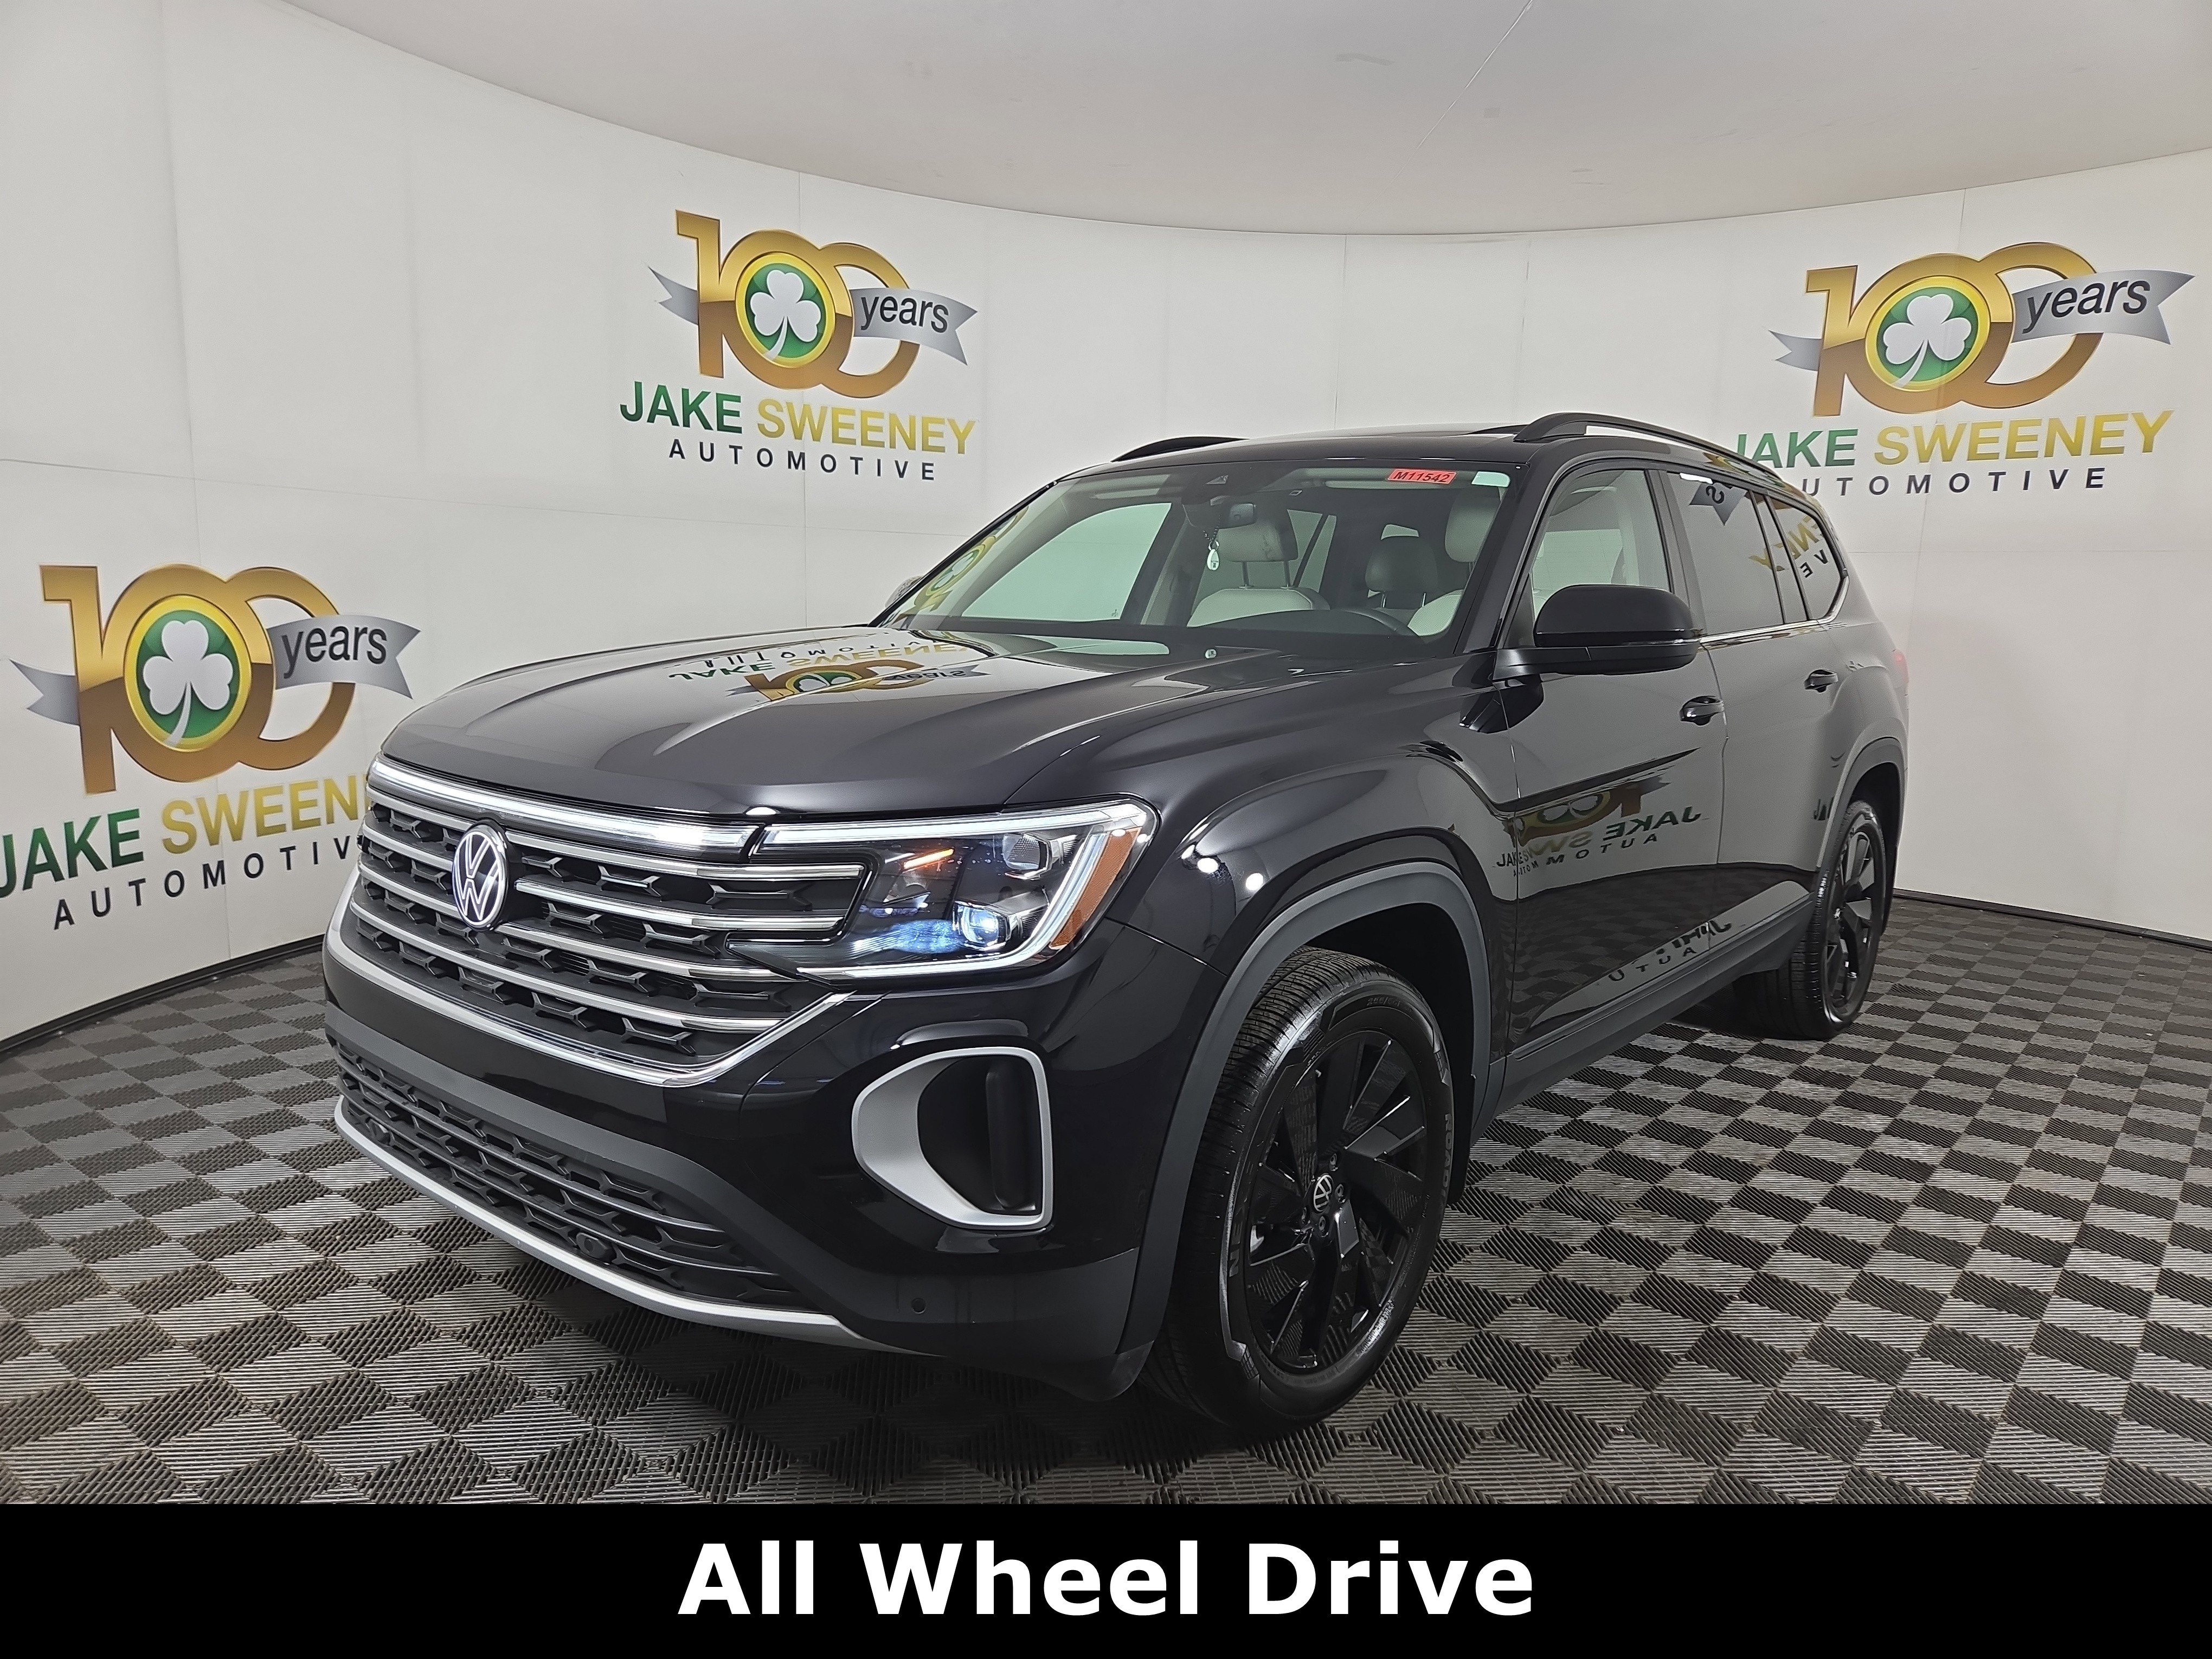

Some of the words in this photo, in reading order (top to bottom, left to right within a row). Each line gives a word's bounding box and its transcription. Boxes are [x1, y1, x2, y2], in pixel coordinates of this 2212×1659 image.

[675, 209, 920, 398] 100
[860, 295, 949, 333] years
[1806, 242, 2103, 416] 100
[2022, 280, 2150, 333] years
[620, 381, 743, 434] JAKE
[757, 398, 975, 454] SWEENEY
[1874, 410, 2174, 465] SWEENEY
[668, 439, 935, 480] AUTOMOTIVE
[1393, 472, 1450, 482] M11542
[1802, 467, 2105, 497] UTOMOTIVE
[39, 564, 356, 795] 100
[281, 626, 387, 679] years
[162, 774, 369, 854] SWEEN
[54, 835, 350, 929] AUTOMOTIV
